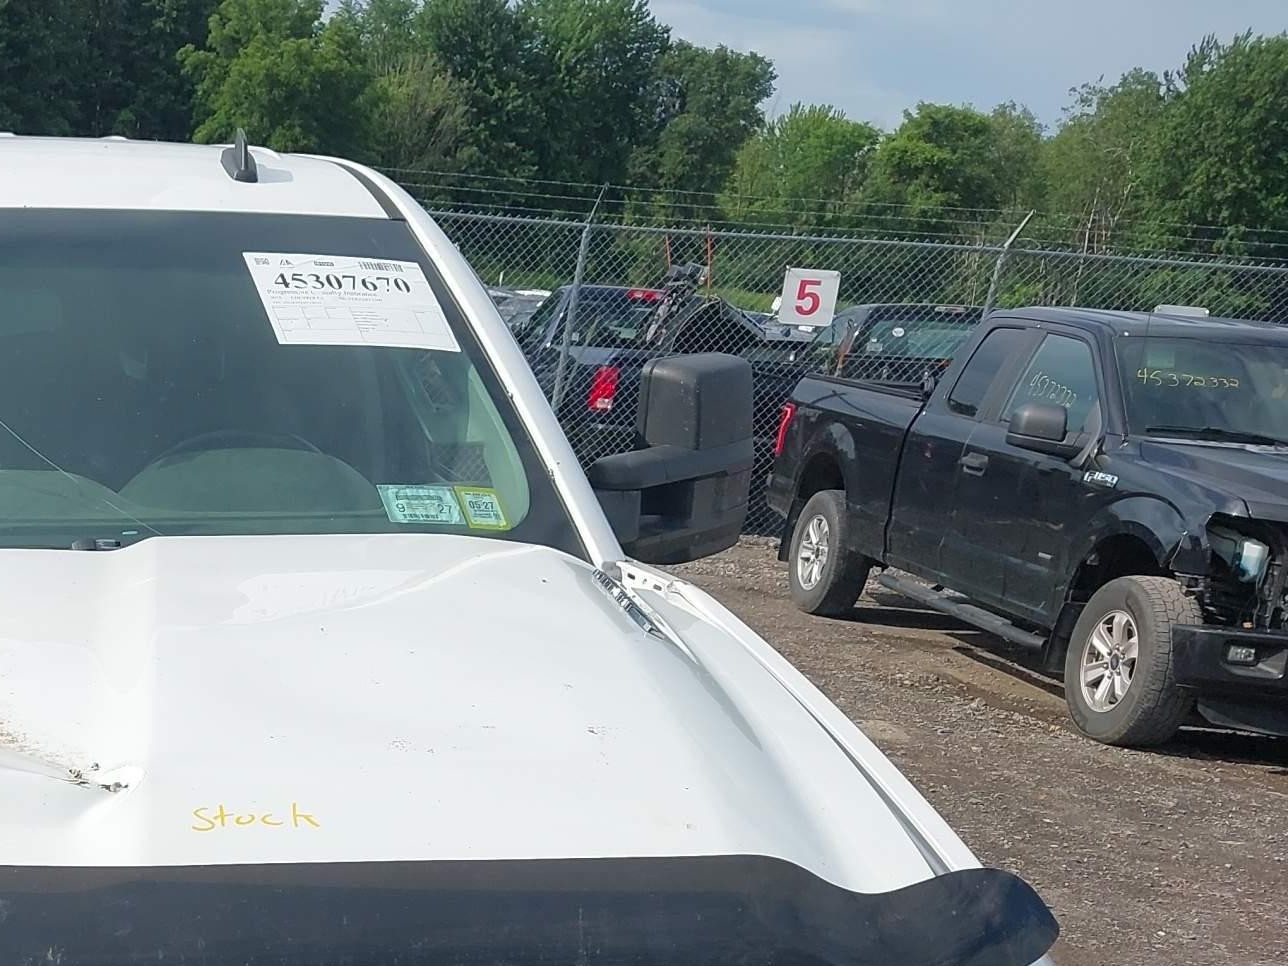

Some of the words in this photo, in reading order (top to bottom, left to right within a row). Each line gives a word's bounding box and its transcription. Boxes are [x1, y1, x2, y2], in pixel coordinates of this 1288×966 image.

[274, 272, 412, 295] 45307670
[795, 279, 822, 315] 5
[1136, 367, 1240, 389] 45372332
[437, 503, 452, 515] 27
